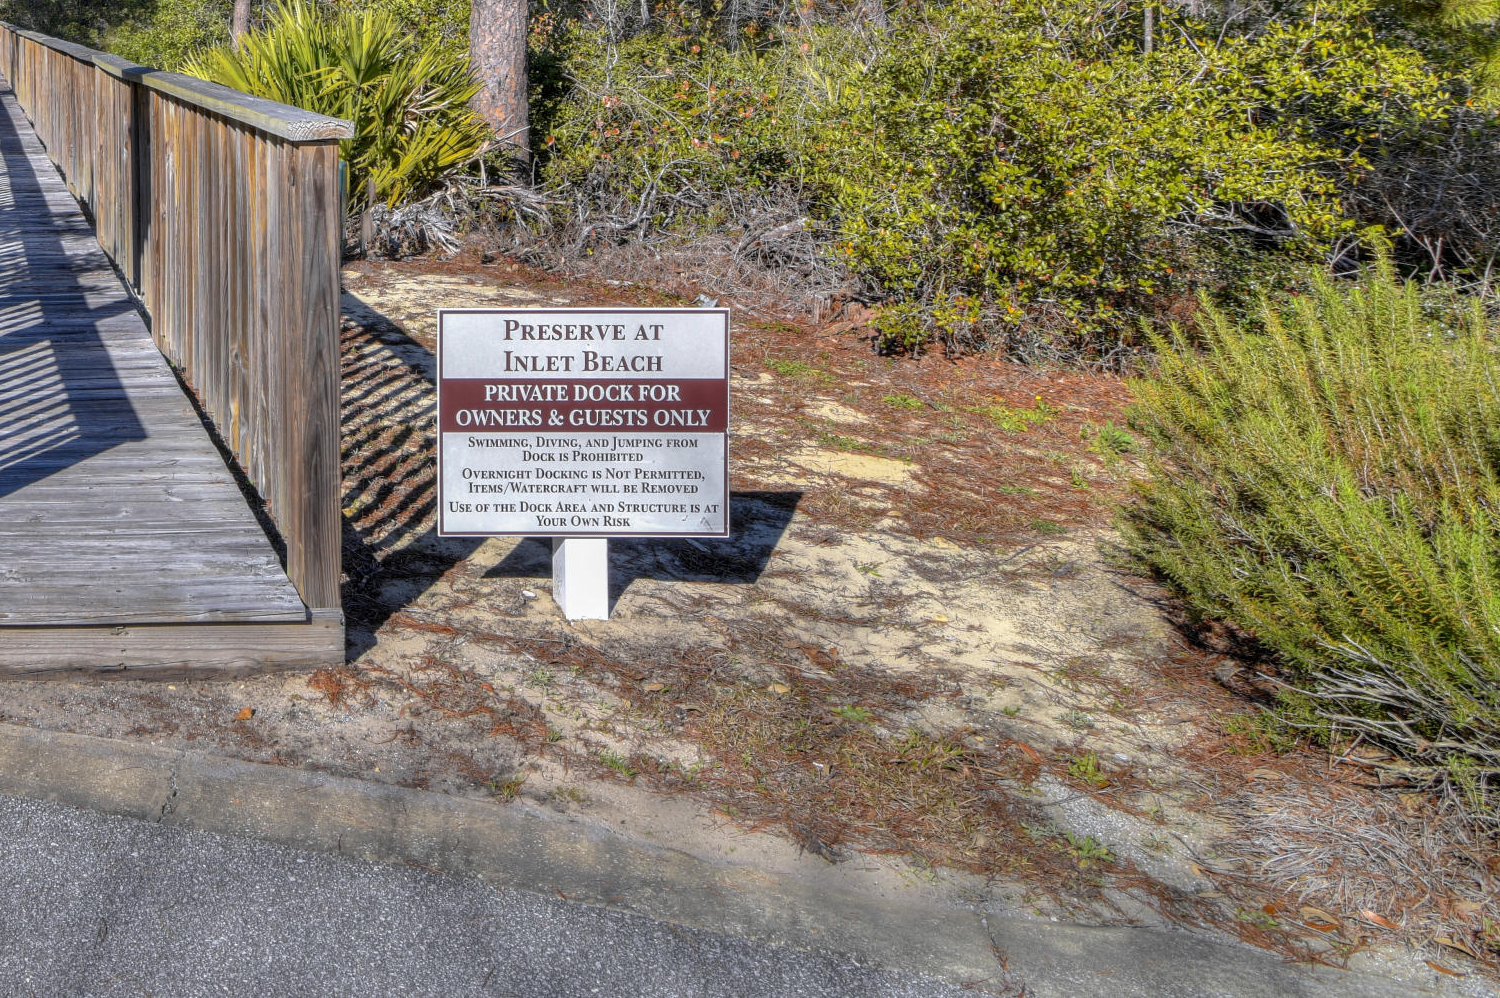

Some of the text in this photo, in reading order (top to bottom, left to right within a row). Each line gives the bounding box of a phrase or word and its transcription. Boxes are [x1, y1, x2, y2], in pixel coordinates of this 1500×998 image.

[503, 319, 664, 341] PRESERVE AT
[503, 351, 663, 372] INLET BEACH
[484, 384, 681, 401] PRIVATE DOCK FOR
[456, 410, 711, 426] OWNERS & GUESTS ONLY
[468, 437, 698, 451] SWIMMING, DIVING, AND JUMPING FROM
[523, 451, 643, 462] DOCK IS PROHIBITED
[462, 468, 705, 481] OVERNIGHT DOCKING IS NOT PERMITTED,
[468, 482, 698, 494] ITEMS/WATERCRAFT WILL BE REMOVED
[449, 502, 719, 513] USE OF THE DOCK AREA AND STRUCTURE IS AT
[536, 516, 630, 527] YOUR OWN RISK
